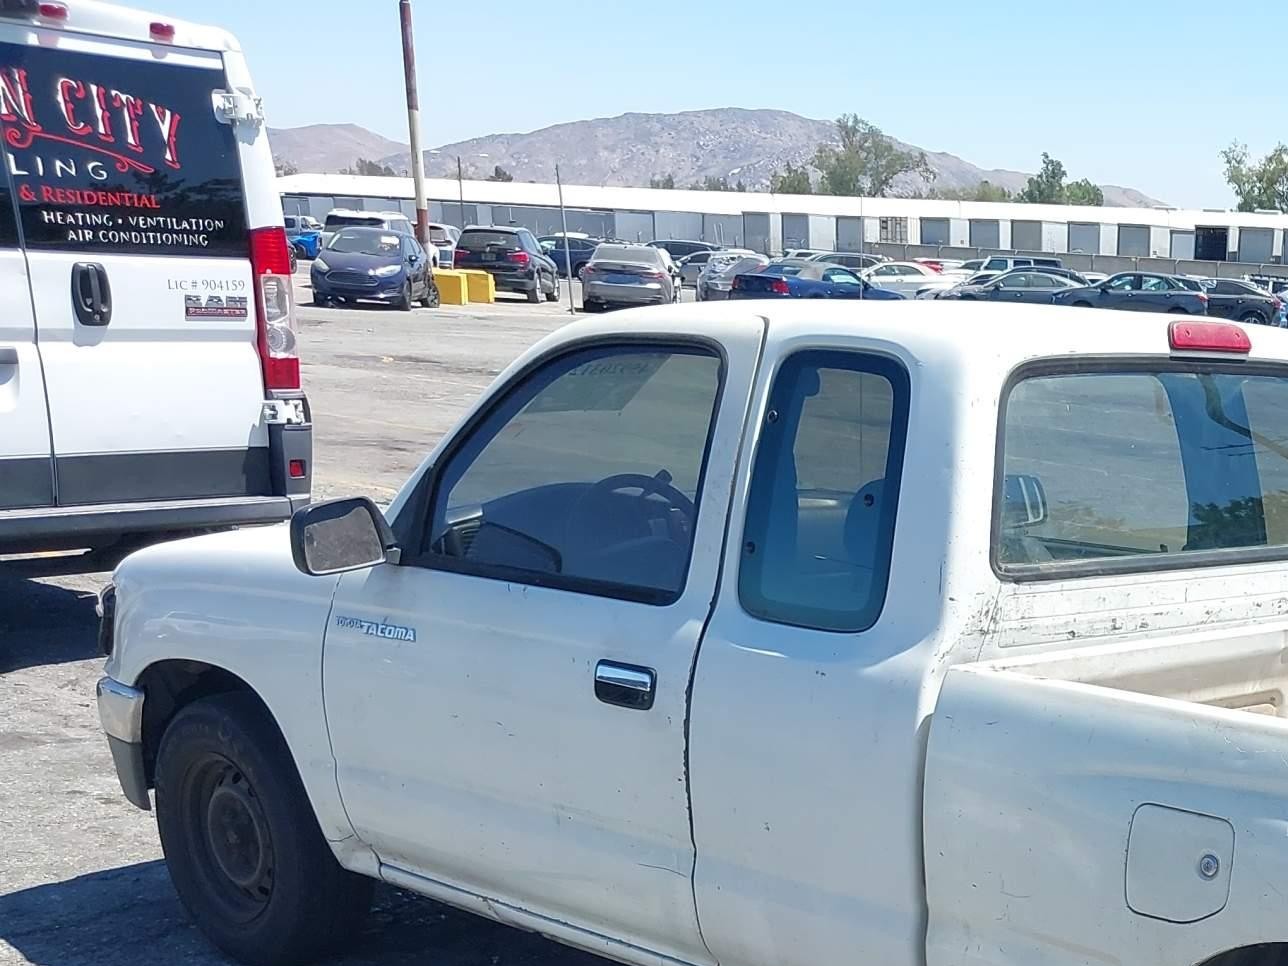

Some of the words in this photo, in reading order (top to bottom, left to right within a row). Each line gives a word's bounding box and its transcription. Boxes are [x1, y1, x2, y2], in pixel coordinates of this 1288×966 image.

[57, 77, 181, 169] CITY
[18, 183, 36, 202] &
[42, 186, 161, 209] RESIDENTIAL
[42, 210, 113, 227] HEATING
[128, 216, 224, 230] VENTILATION
[68, 228, 93, 242] AIR
[99, 229, 209, 247] CONDITIONING
[191, 279, 198, 290] #
[201, 279, 245, 292] 904159
[360, 620, 417, 643] TACOMA
